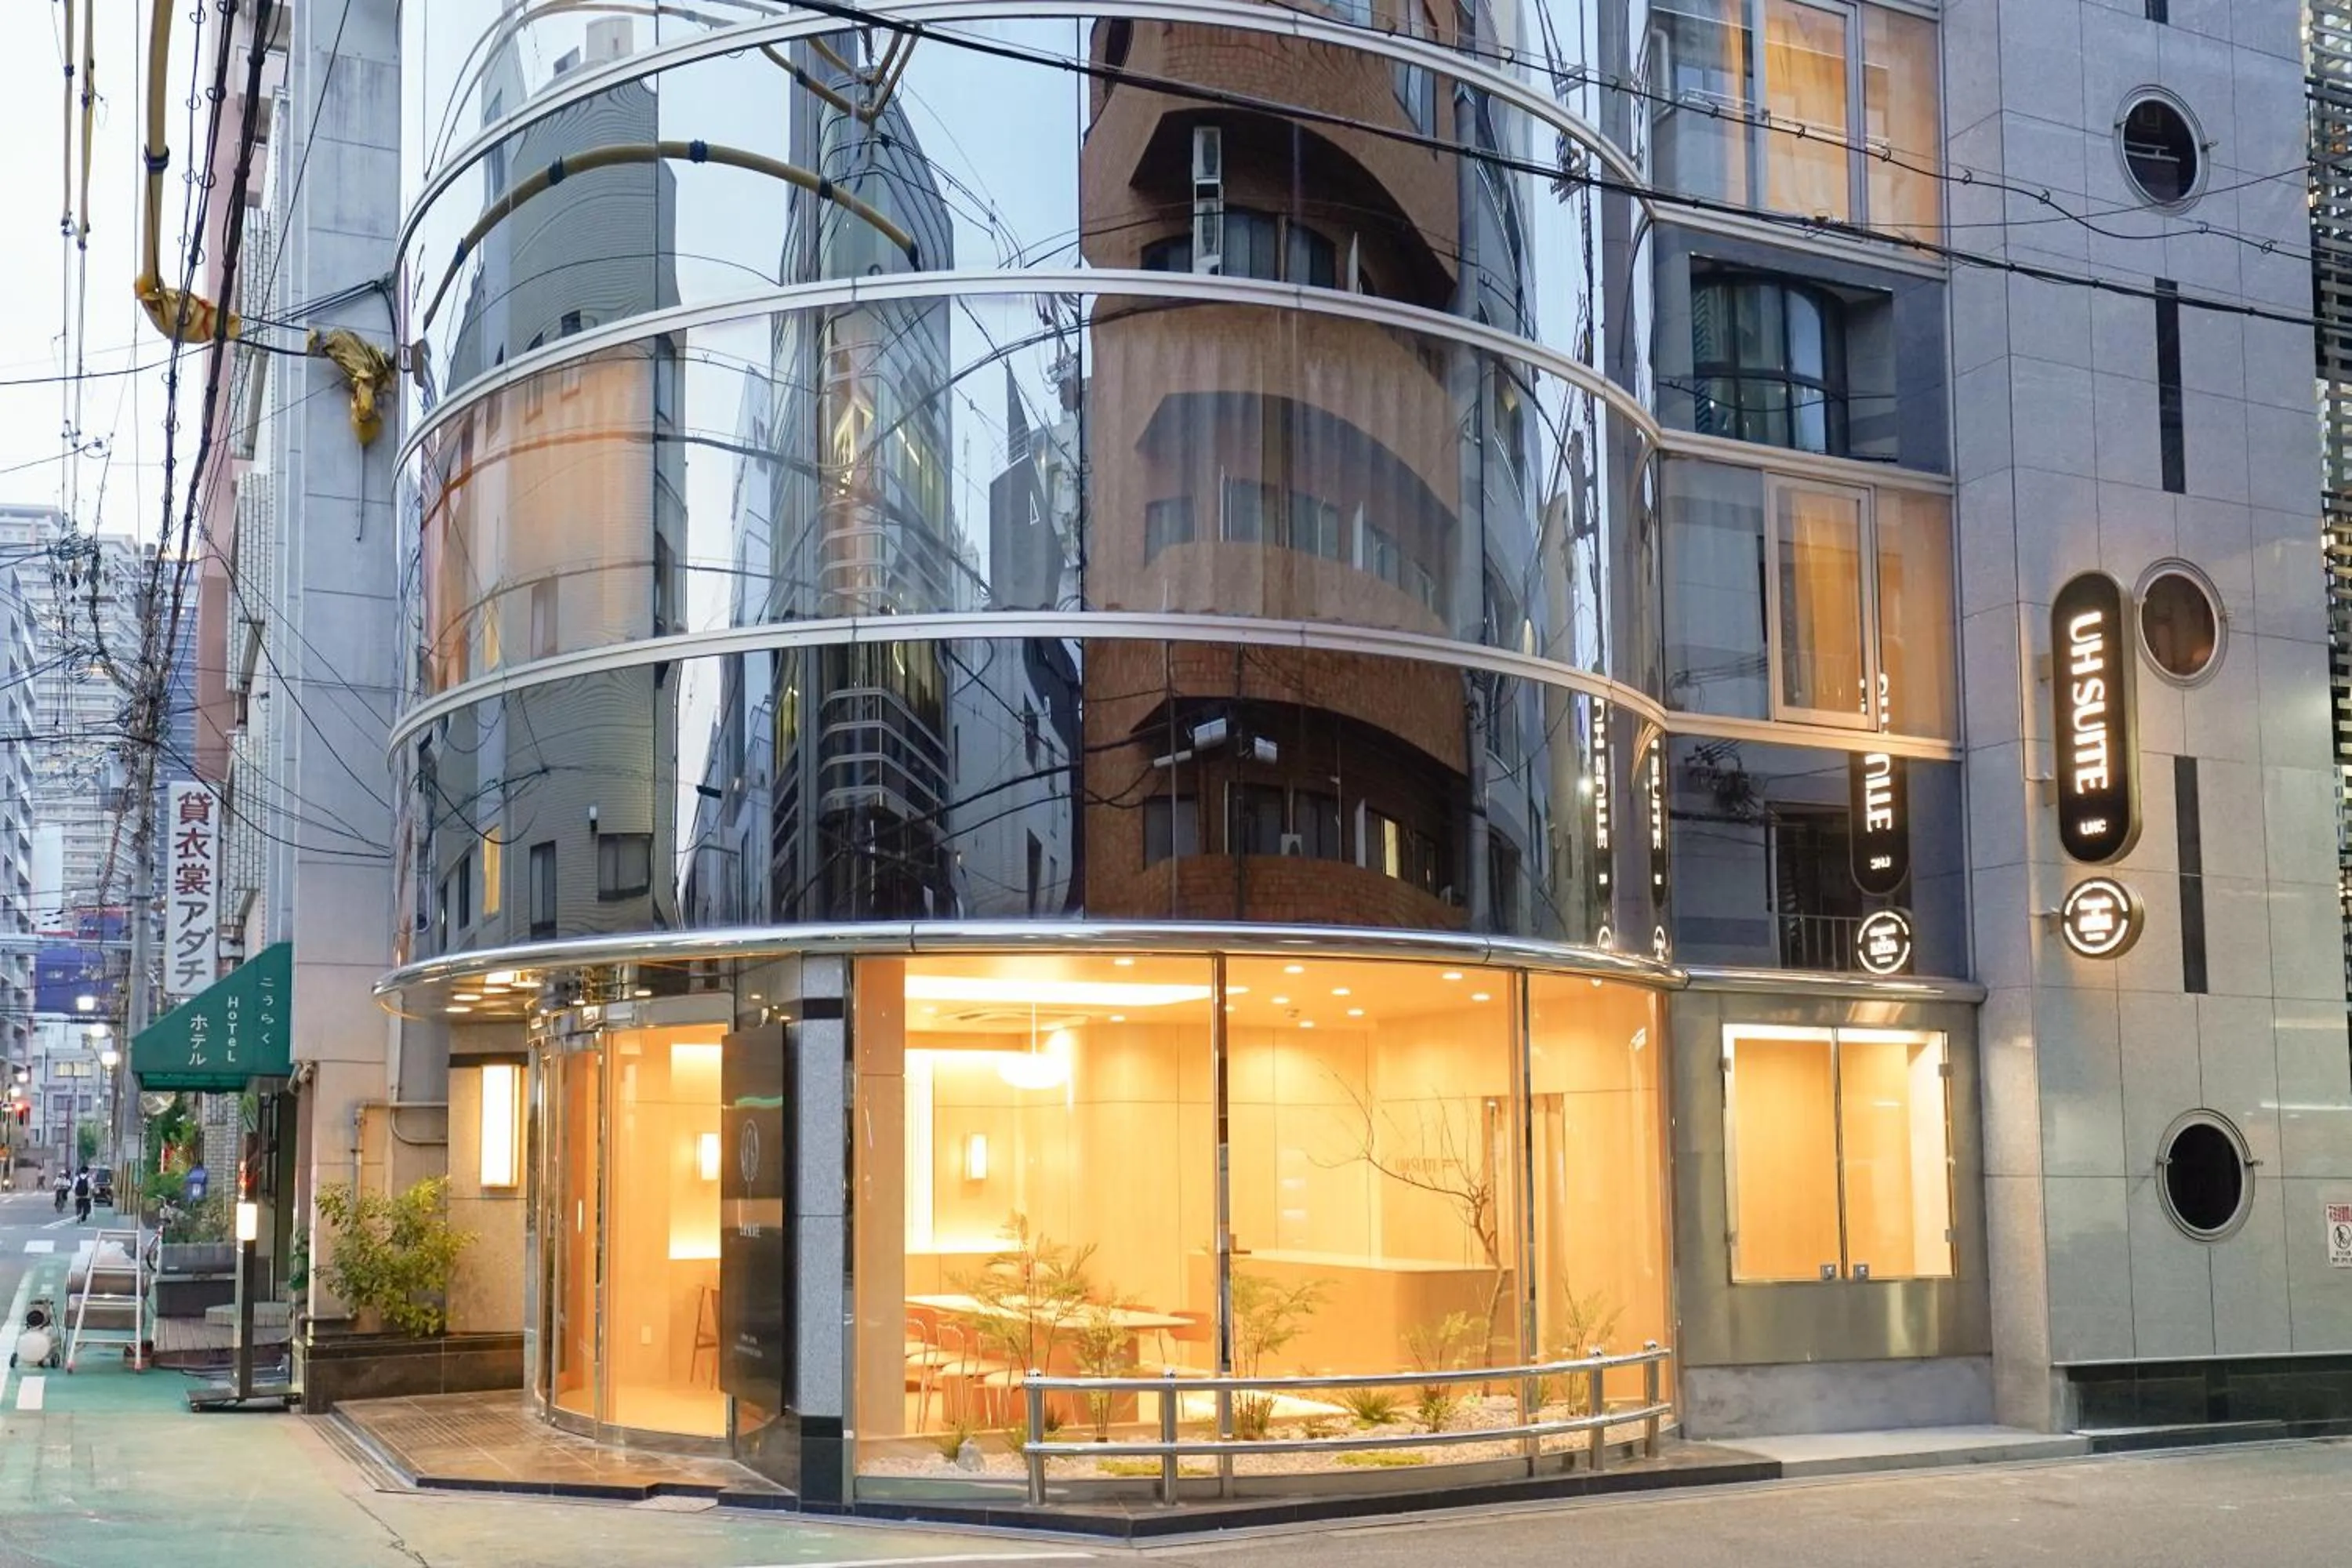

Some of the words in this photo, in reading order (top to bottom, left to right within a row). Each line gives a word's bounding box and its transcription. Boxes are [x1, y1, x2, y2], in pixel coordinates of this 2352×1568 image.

[2070, 611, 2103, 675] UH
[2072, 677, 2109, 794] SUITE
[175, 791, 214, 987] 貸衣裳アダチ
[188, 1013, 209, 1066] ホテル
[260, 977, 275, 1045] こうらく
